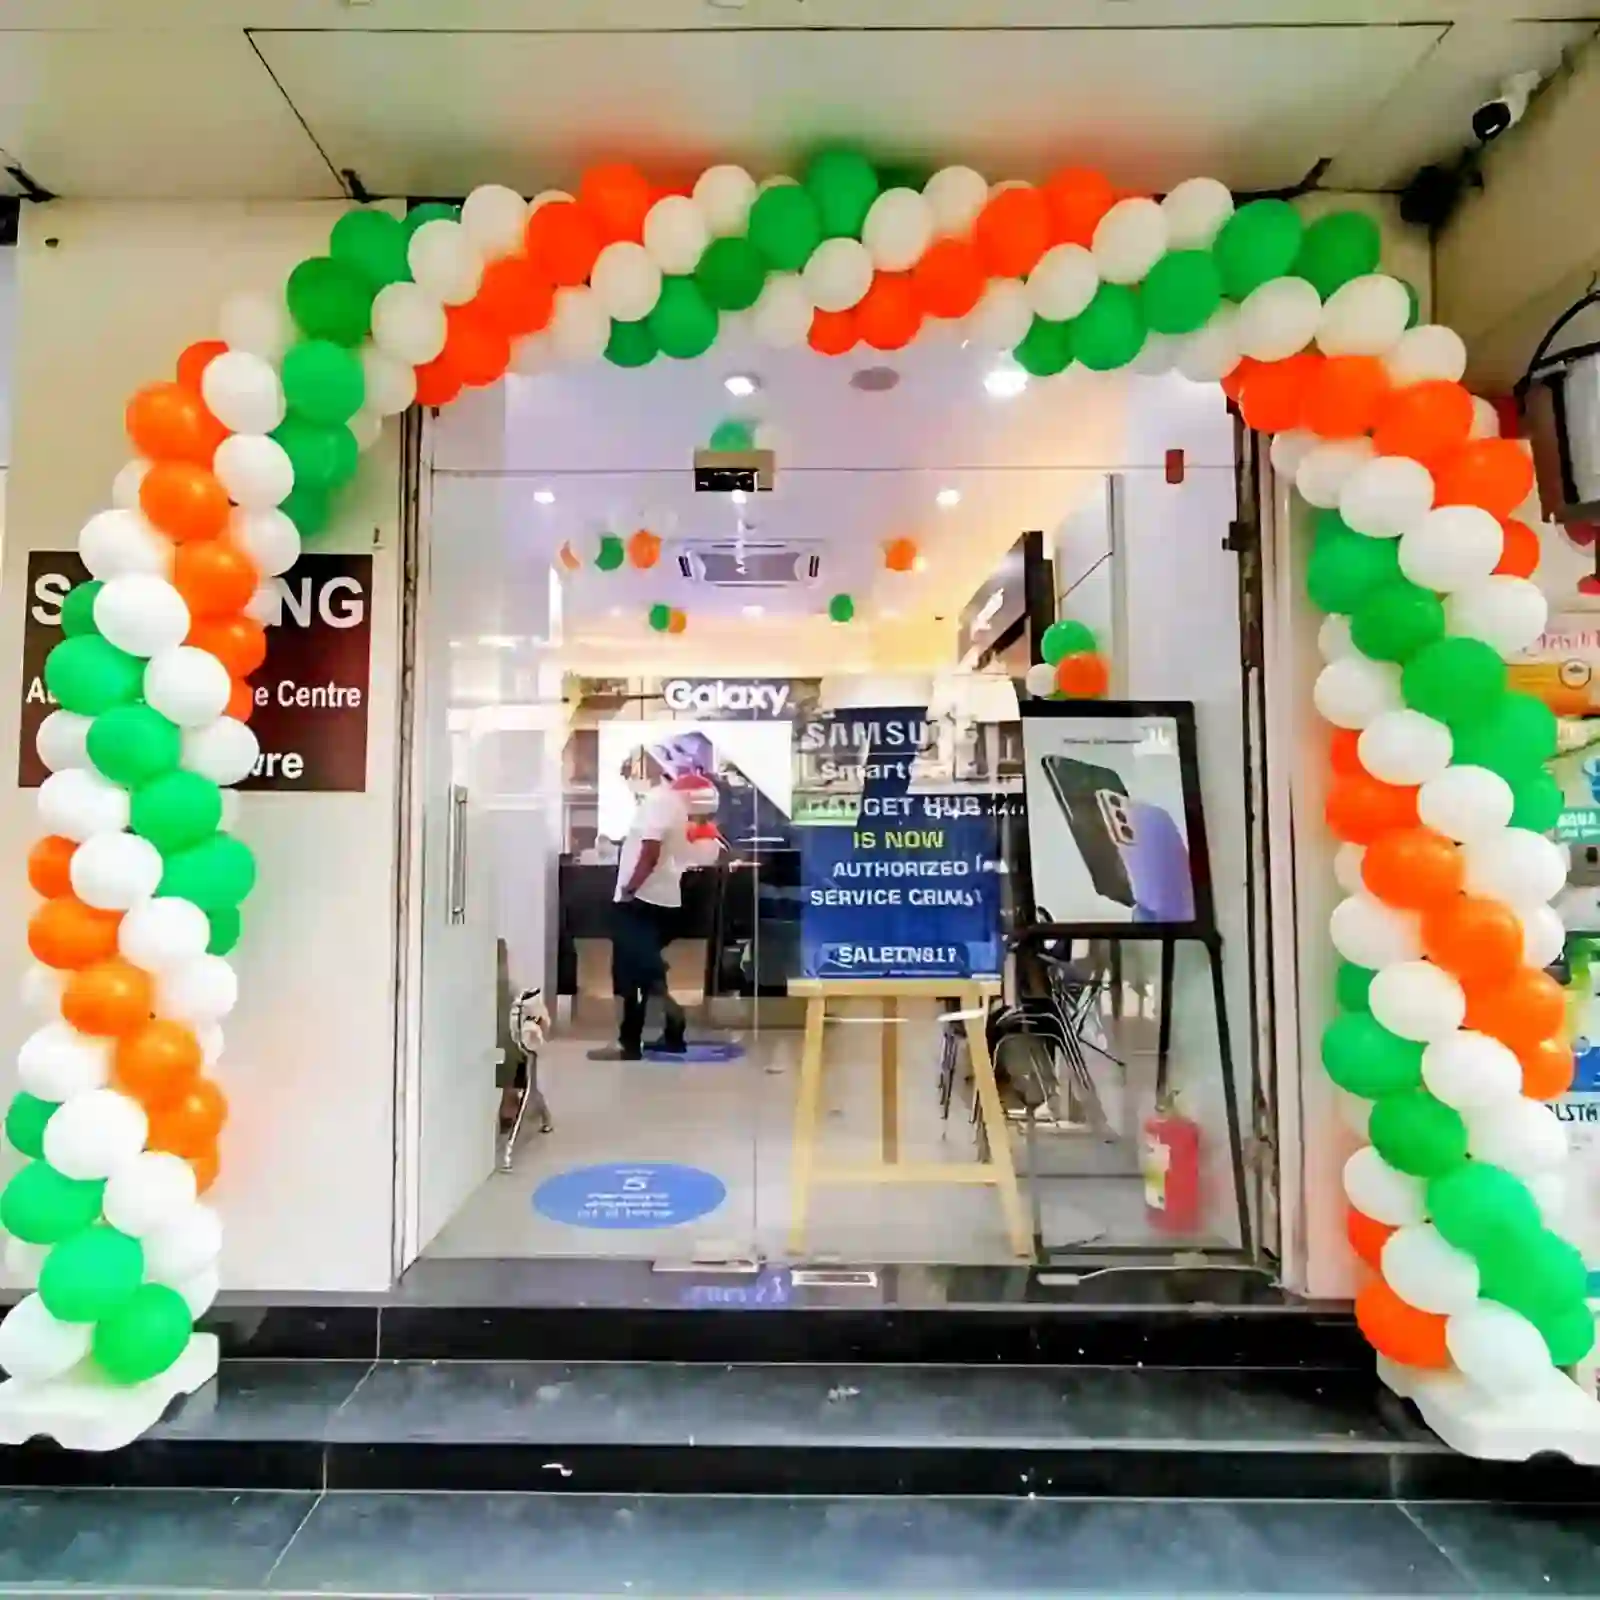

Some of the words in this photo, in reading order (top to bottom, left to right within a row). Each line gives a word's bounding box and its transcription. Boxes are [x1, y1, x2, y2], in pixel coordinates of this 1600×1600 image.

[277, 679, 362, 708] Centre
[664, 679, 790, 717] Galaxy
[805, 720, 930, 748] SAMSU
[852, 830, 877, 849] IS
[884, 830, 945, 849] NOW
[832, 860, 970, 878] AUTHORIZED
[810, 888, 902, 906] SERVICE
